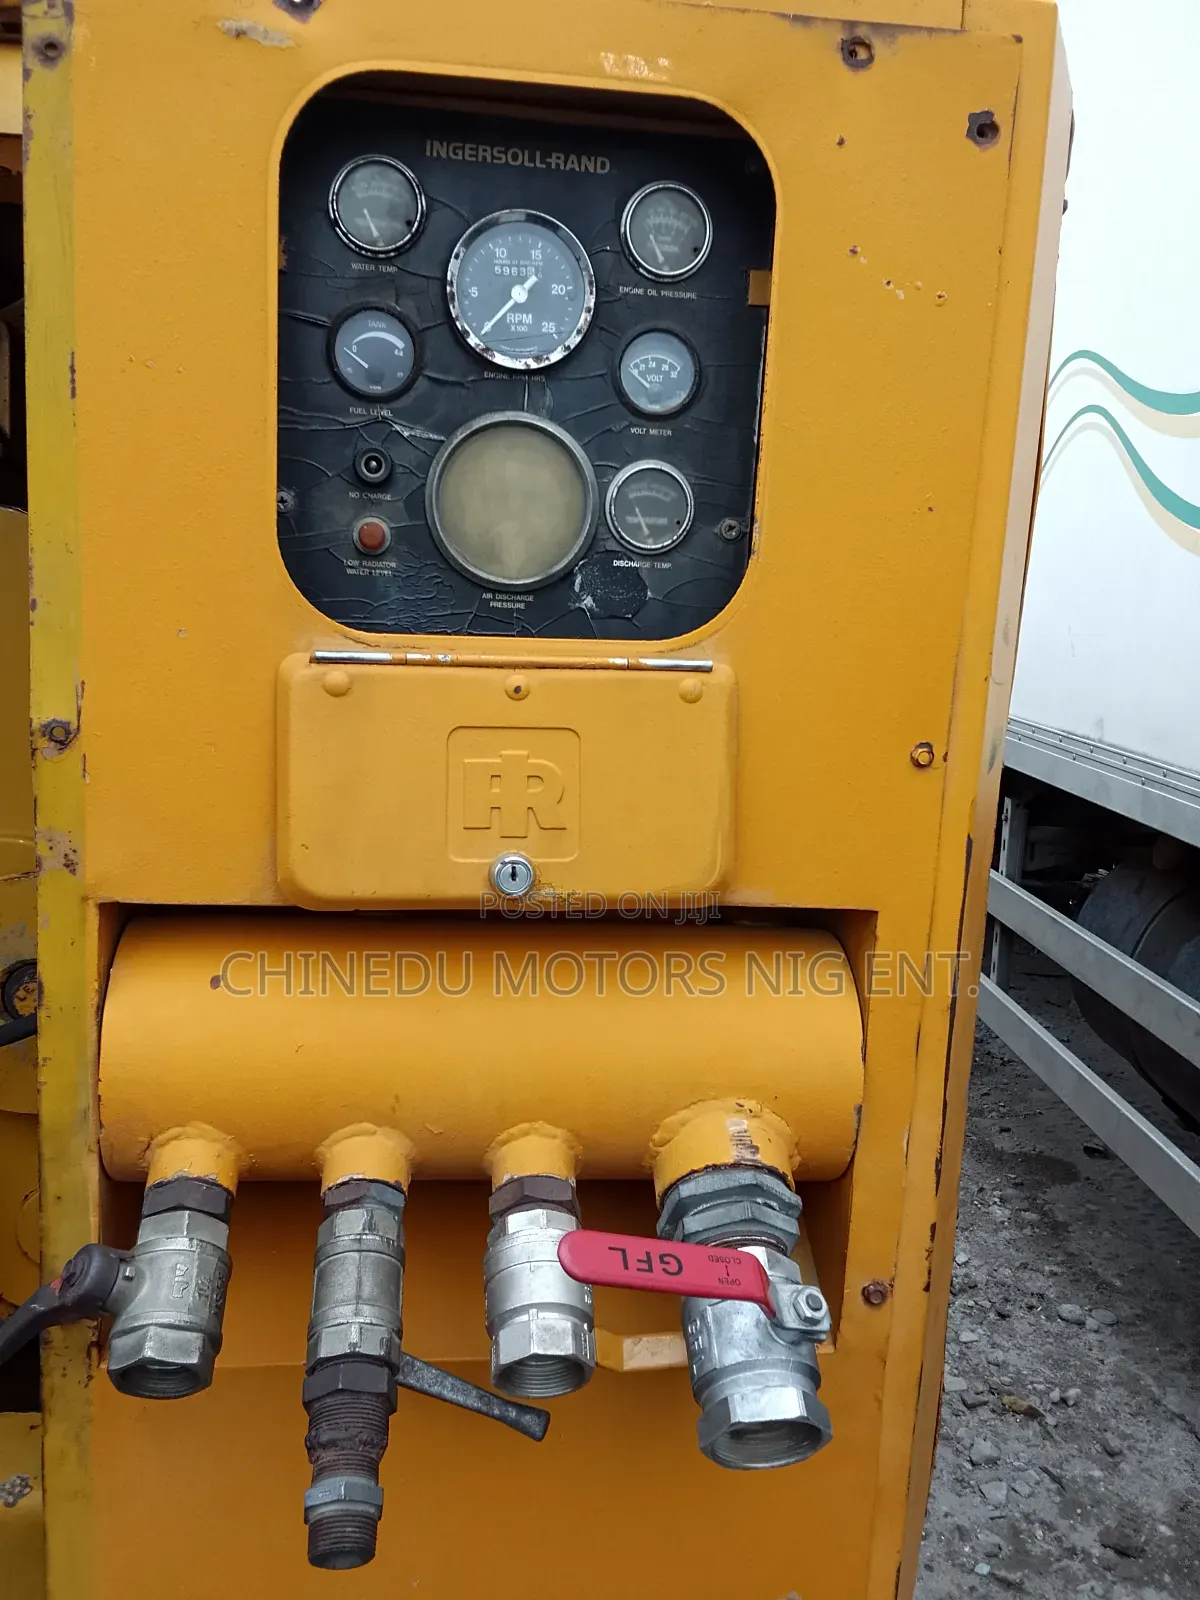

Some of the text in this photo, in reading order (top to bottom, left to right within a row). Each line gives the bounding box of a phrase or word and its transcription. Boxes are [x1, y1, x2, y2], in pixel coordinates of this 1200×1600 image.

[426, 139, 611, 174] INGERSOLL-RAND
[494, 247, 507, 258] 10
[531, 249, 542, 260] 15
[351, 262, 375, 272] WATER
[471, 287, 478, 297] 5
[551, 284, 566, 295] 20
[619, 286, 697, 300] ENGINE OIL PRESSURE
[507, 313, 533, 325] RPM
[368, 320, 387, 329] TANK
[541, 321, 556, 333] 25
[352, 345, 357, 353] 0
[484, 371, 509, 380] ENGINE
[646, 374, 664, 383] VOLT
[670, 371, 679, 379] 32
[349, 406, 394, 417] FUEL LEVEL
[630, 427, 672, 437] VOLT METER
[348, 491, 392, 501] NO CHARGE
[343, 559, 397, 569] LOW RADIATOR
[613, 559, 651, 568] DISCHARGE
[346, 568, 393, 577] WATER LEVEL
[482, 592, 534, 602] AIR DISCHARGE
[489, 601, 526, 610] PRESSURE
[608, 1246, 684, 1276] GFL
[708, 1254, 742, 1265] CLOSED
[718, 1277, 742, 1286] OPEN
